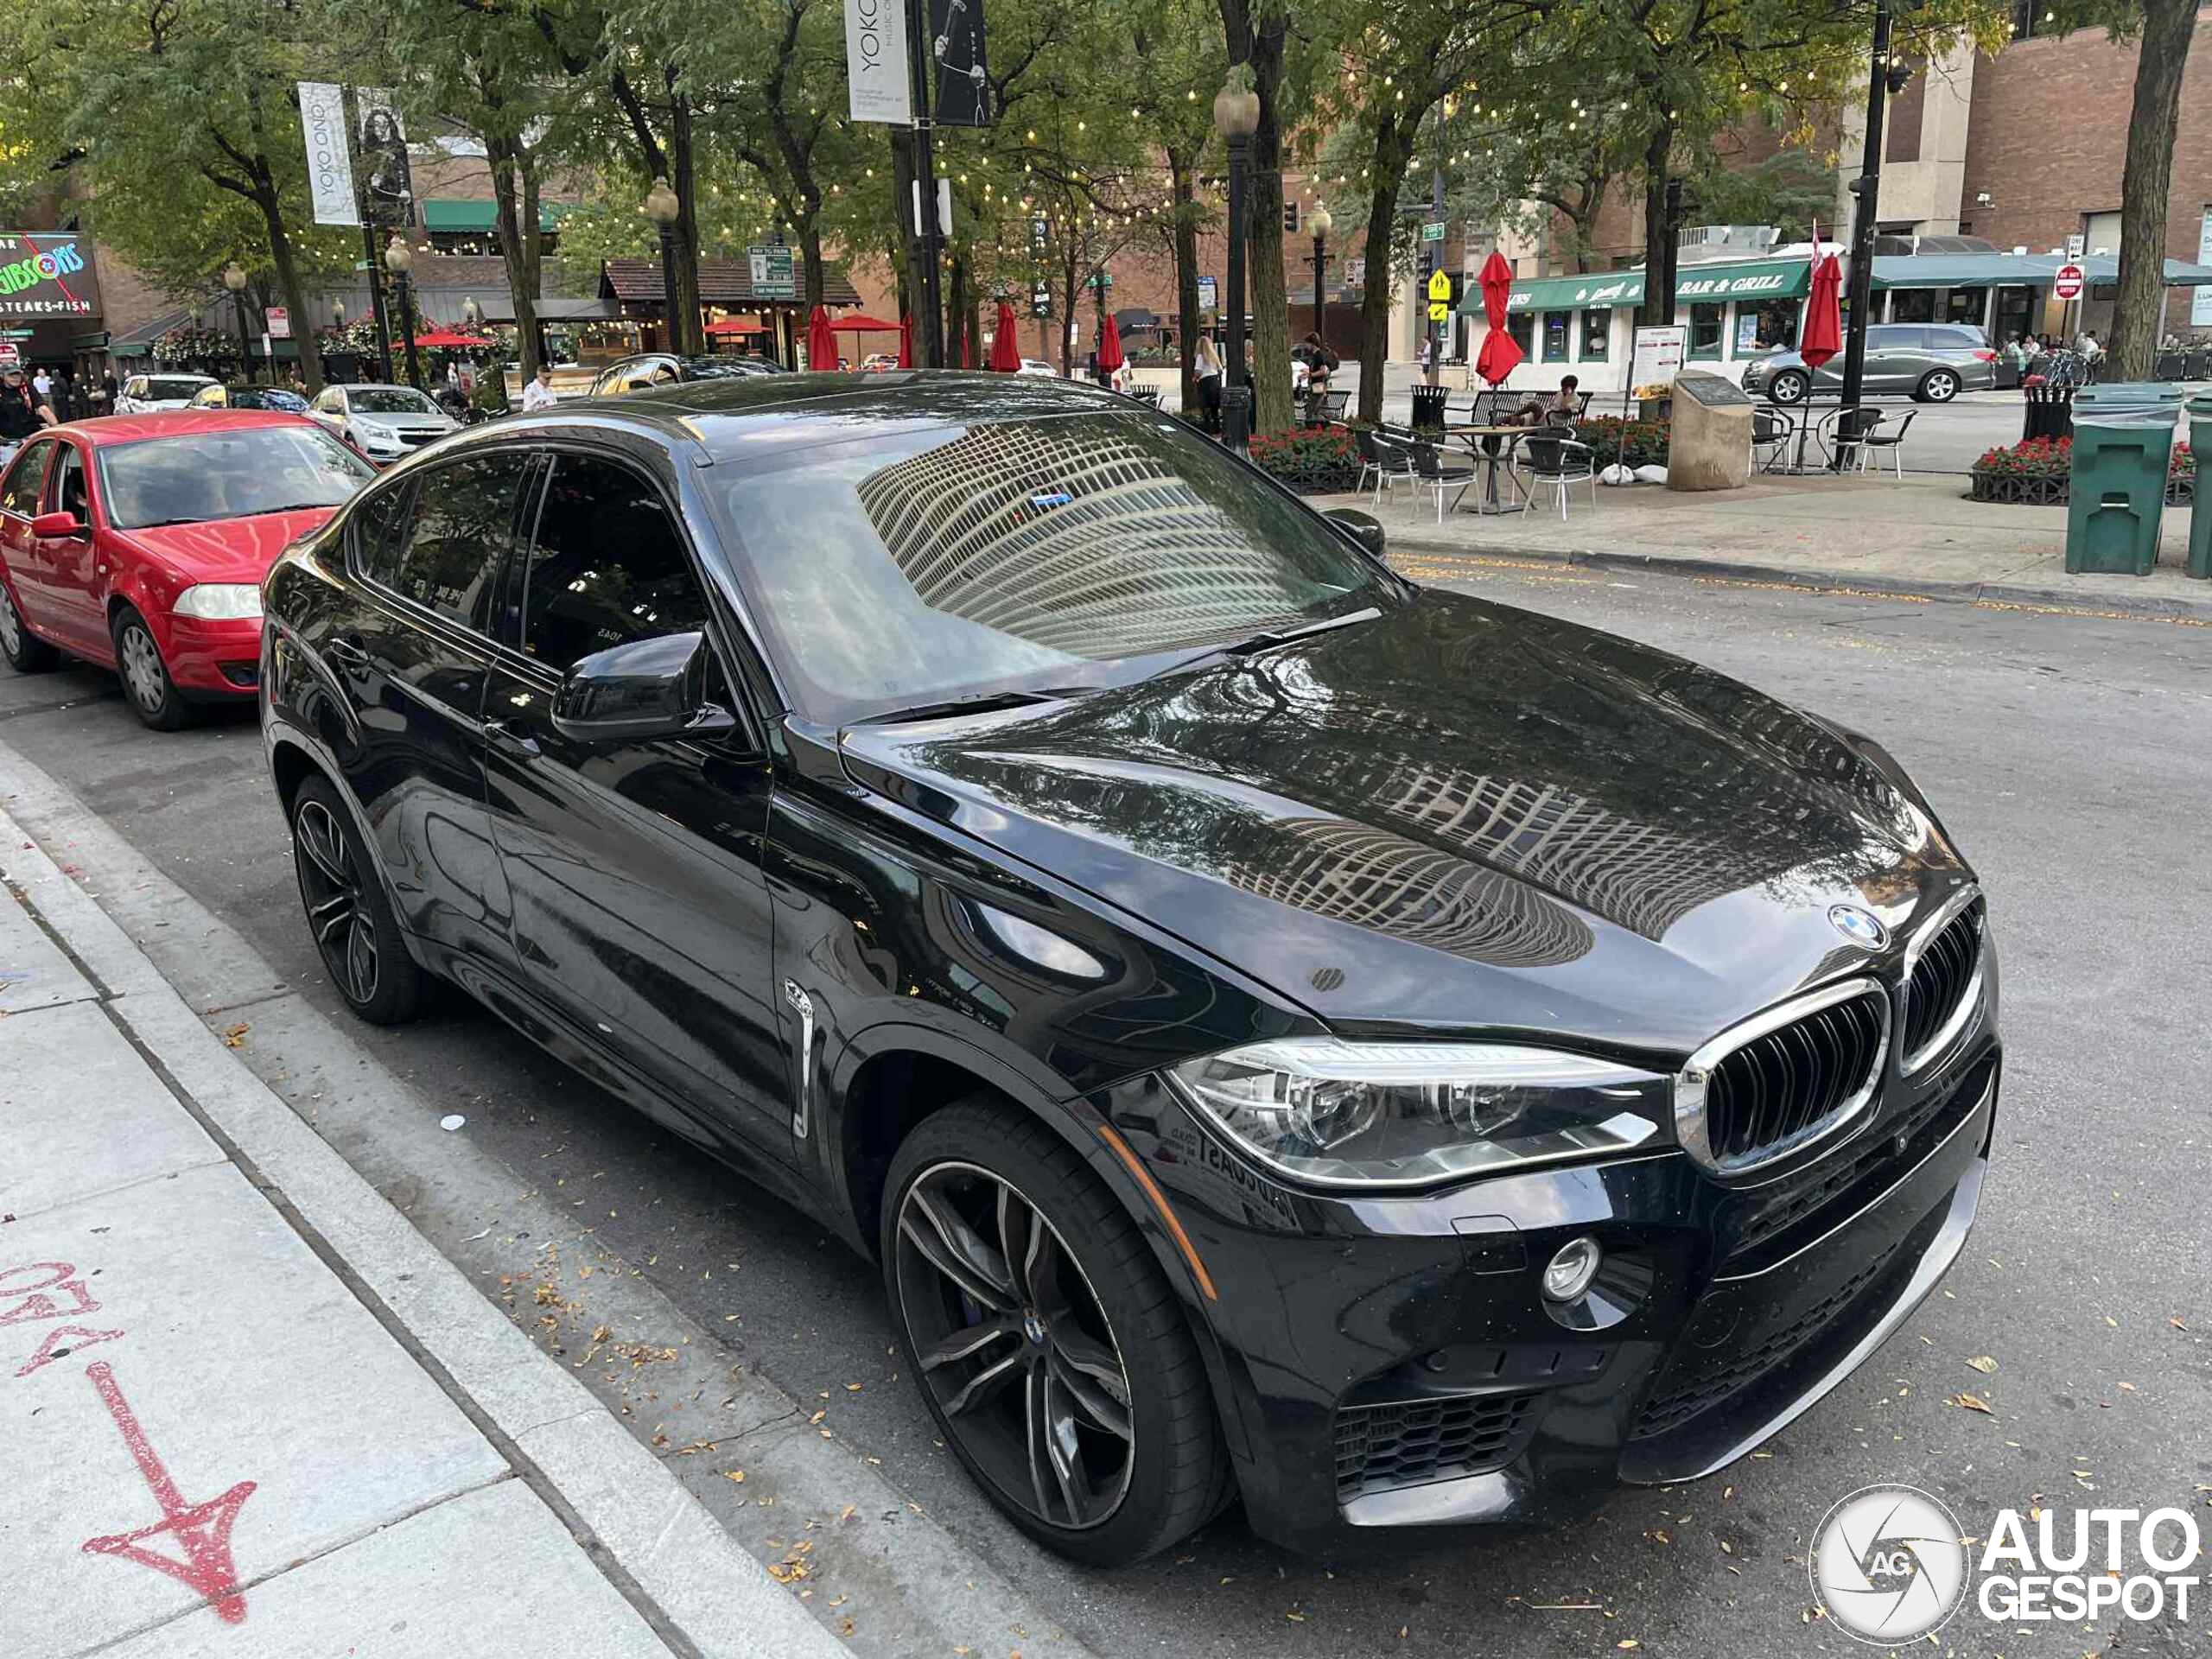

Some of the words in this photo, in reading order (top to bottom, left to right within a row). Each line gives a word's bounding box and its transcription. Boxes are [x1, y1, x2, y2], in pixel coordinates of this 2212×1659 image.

[310, 104, 328, 146] ONO
[317, 150, 335, 196] YOKO
[1675, 279, 1715, 295] BAR
[1713, 279, 1731, 292] &
[1731, 275, 1784, 291] GRILL
